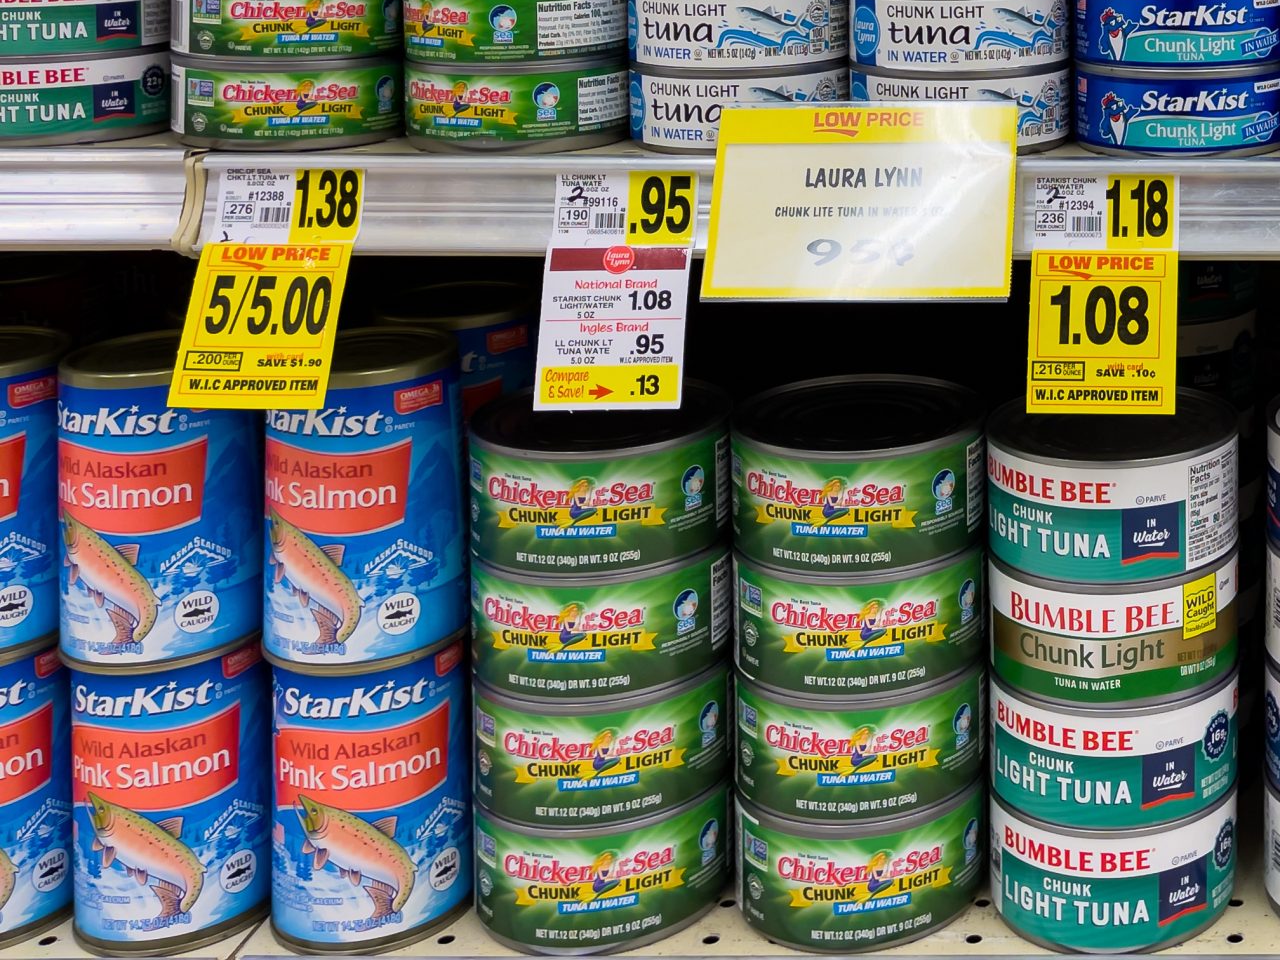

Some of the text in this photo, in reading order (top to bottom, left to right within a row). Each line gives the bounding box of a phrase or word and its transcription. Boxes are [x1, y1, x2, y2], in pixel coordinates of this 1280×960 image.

[806, 168, 866, 188] LAURA
[249, 191, 284, 201] #12388
[297, 170, 358, 227] 1.38
[630, 176, 691, 234] .95
[1059, 201, 1094, 210] #12394
[775, 207, 833, 217] CHUNK LITE
[1106, 180, 1168, 237] 1.18
[575, 280, 658, 289] National Brand
[205, 275, 331, 335] 5/5.00
[628, 291, 672, 310] 1.08
[1051, 286, 1149, 345] 1.08
[580, 323, 649, 335] Ingles Brand
[630, 334, 664, 355] .95
[190, 379, 318, 390] W.I.C APPROVED ITEM
[546, 370, 589, 383] Compare
[630, 375, 659, 396] .13
[84, 460, 167, 478] Alaskan
[81, 481, 193, 508] Salmon
[488, 476, 653, 507] Chicken Sea
[509, 507, 651, 523] CHUNK LIGHT
[181, 596, 214, 611] WILD
[181, 615, 214, 629] CAUGHT
[1020, 632, 1165, 671] Chunk Light
[75, 680, 214, 719] StarKist
